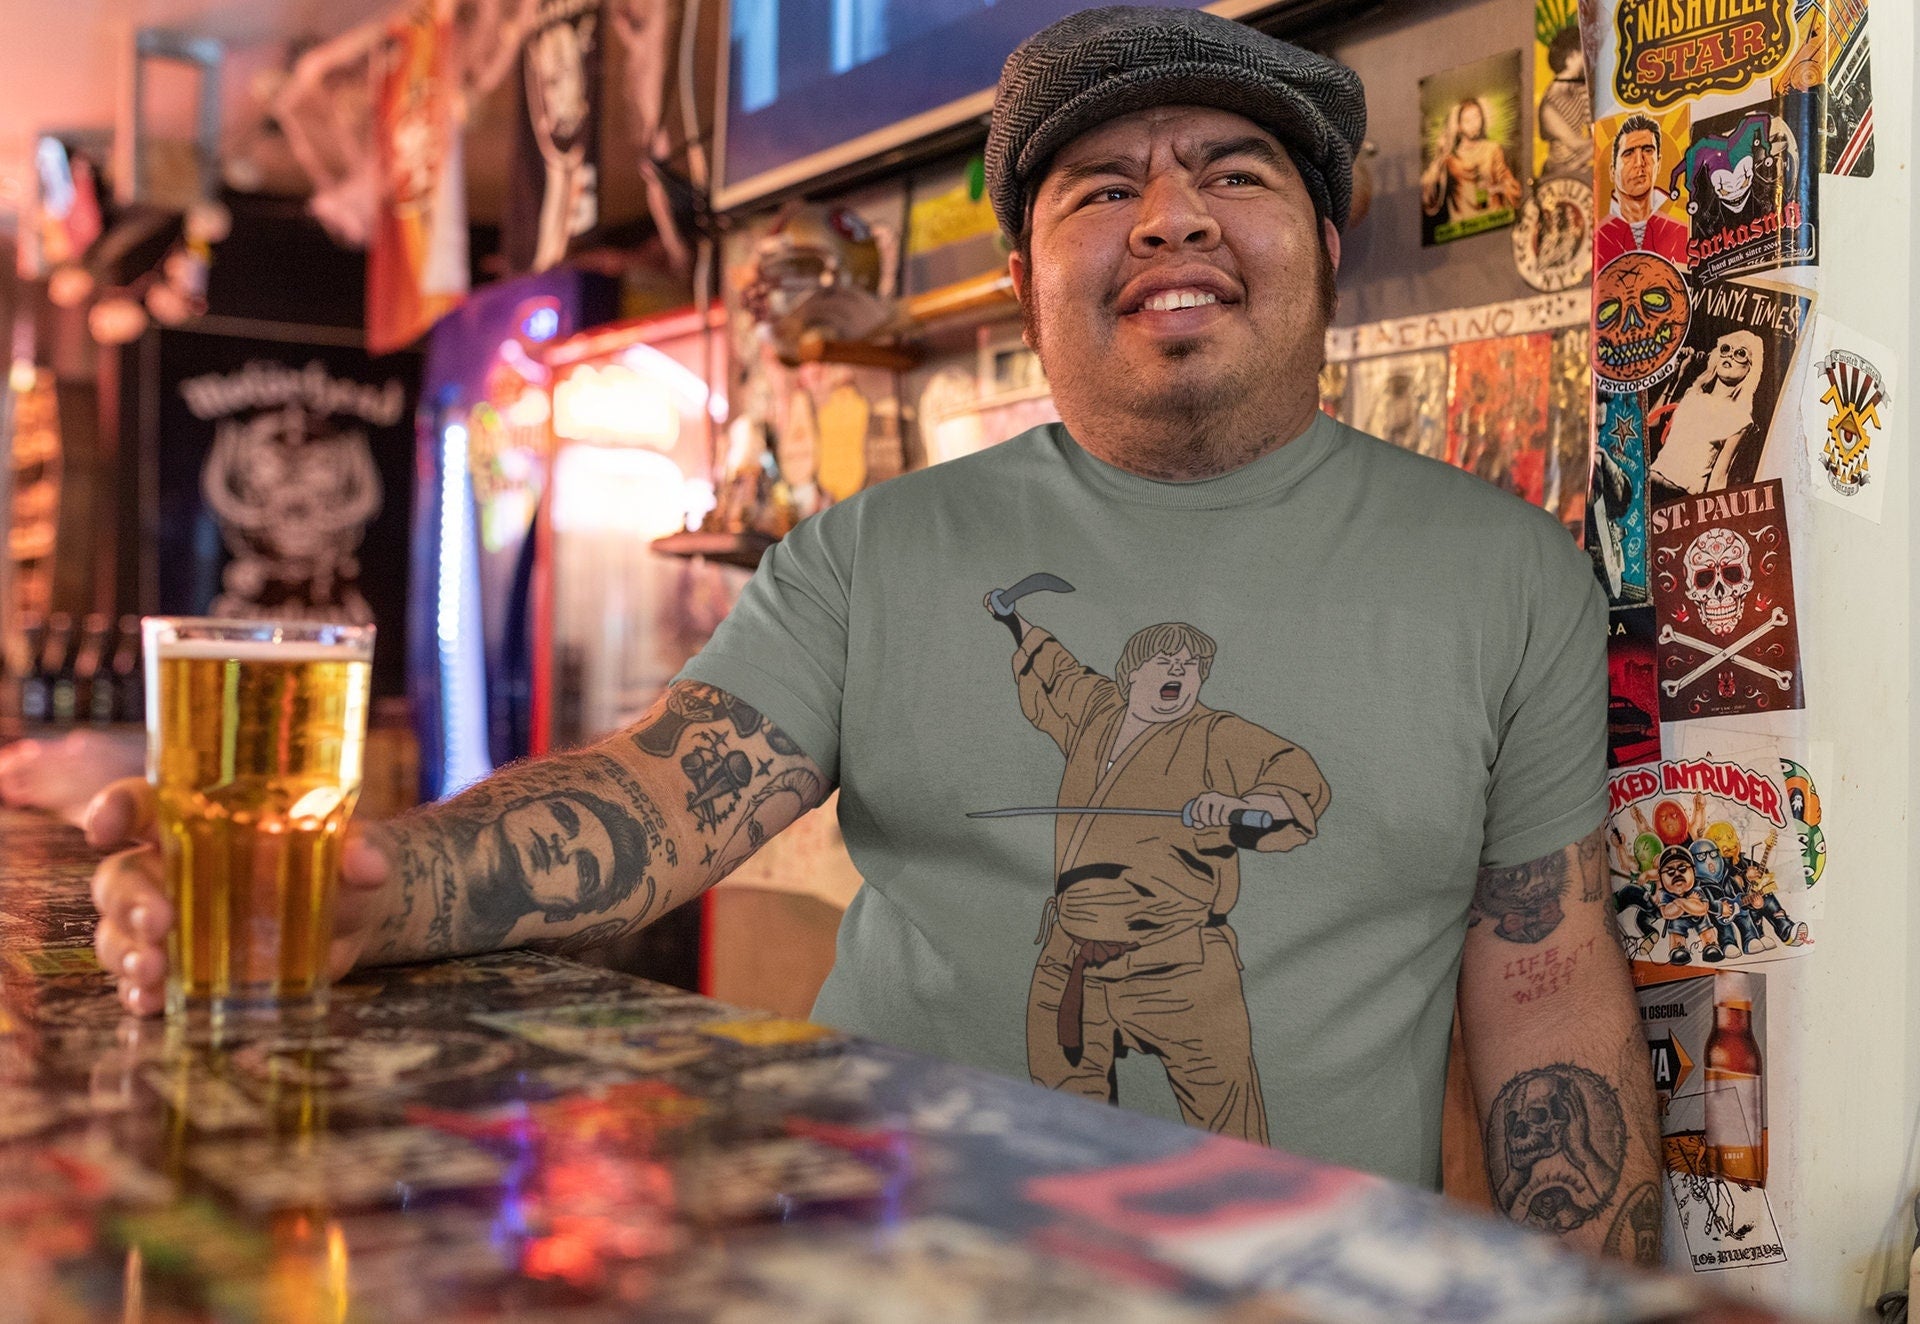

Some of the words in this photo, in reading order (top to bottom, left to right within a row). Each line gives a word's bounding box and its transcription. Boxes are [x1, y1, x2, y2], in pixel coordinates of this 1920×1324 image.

[1637, 0, 1767, 43] NASHVI
[1636, 21, 1766, 84] STAR
[1711, 258, 1728, 272] hard
[1727, 252, 1744, 266] punk
[1745, 245, 1762, 258] since
[1652, 503, 1690, 534] ST.
[1696, 486, 1775, 523] PAULI
[1662, 761, 1782, 823] INTRUDER
[629, 780, 667, 830] BOYS
[665, 838, 678, 868] OF
[1503, 946, 1560, 980] LIFE
[1648, 1003, 1688, 1020] OSCURA.
[1691, 1252, 1716, 1266] LOS
